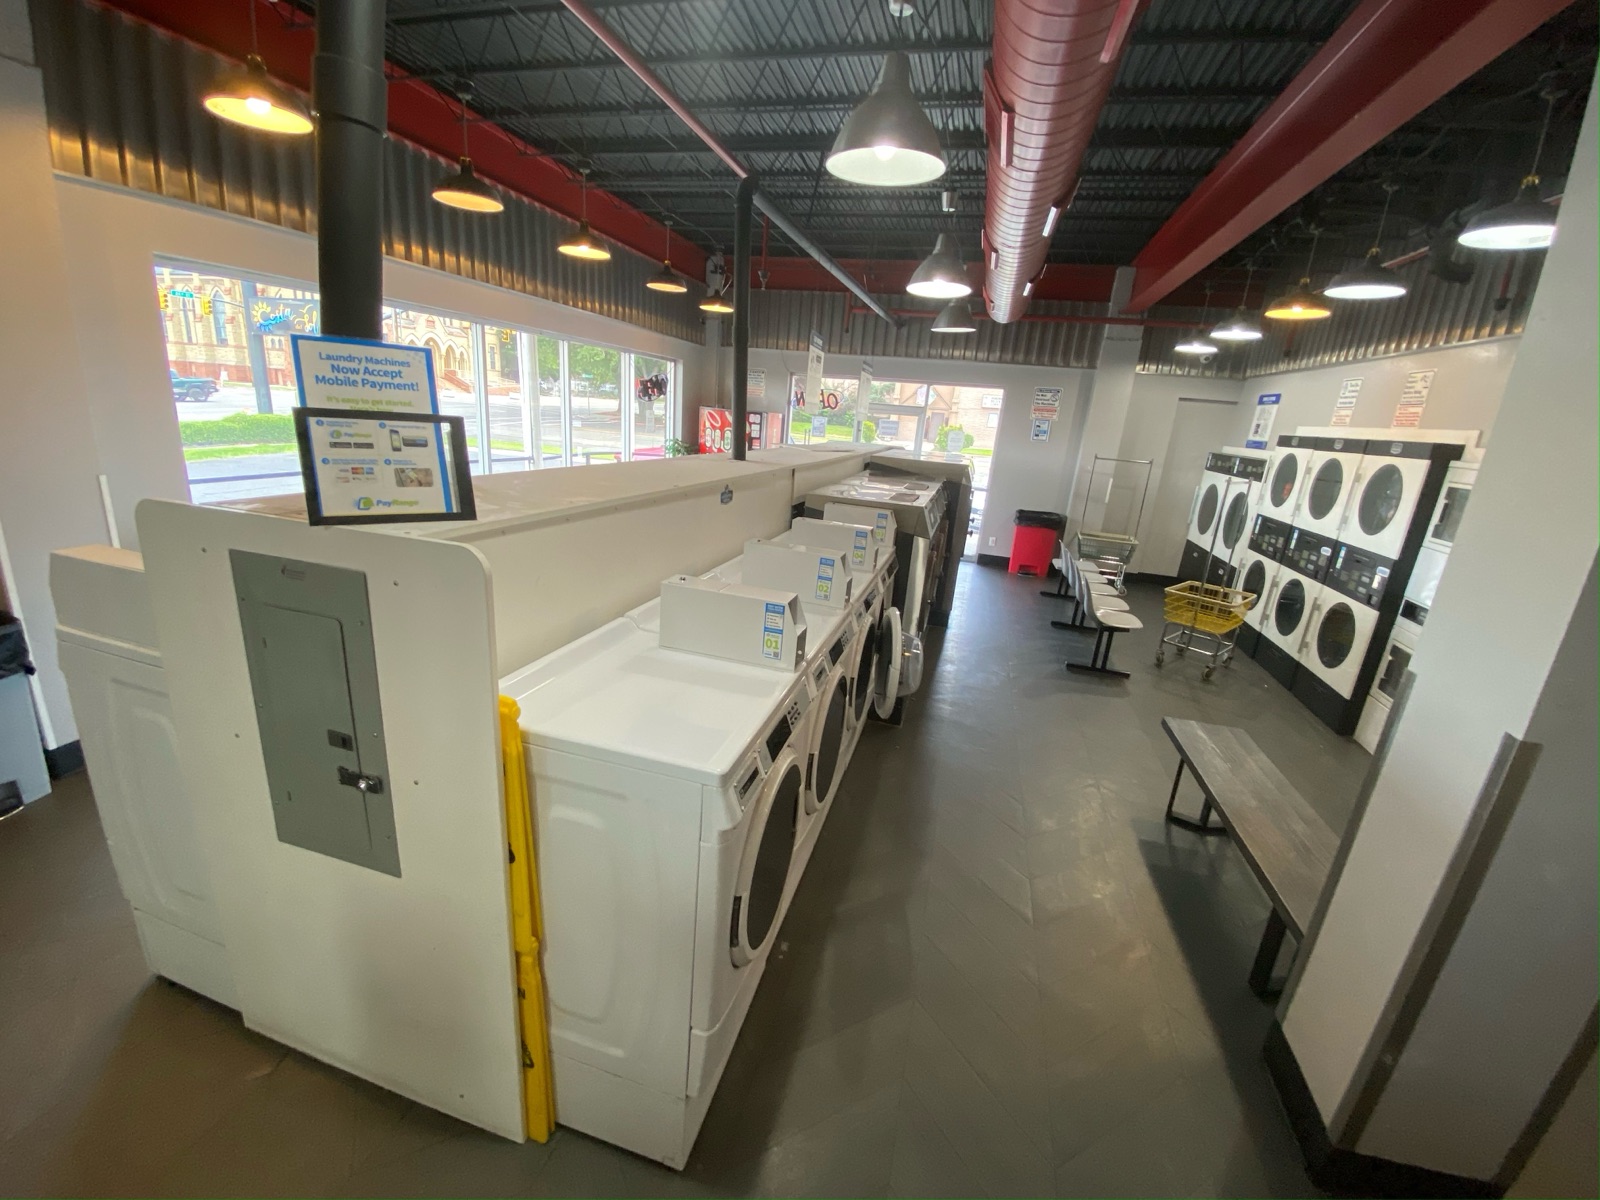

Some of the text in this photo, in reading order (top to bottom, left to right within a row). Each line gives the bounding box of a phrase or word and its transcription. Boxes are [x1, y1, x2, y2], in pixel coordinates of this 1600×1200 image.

[318, 352, 411, 368] Laundry Machines
[330, 364, 403, 380] Now Accept
[314, 374, 419, 391] Mobile Payment!
[340, 397, 360, 406] easy
[360, 397, 370, 405] to
[371, 398, 383, 407] get
[818, 584, 829, 593] 02
[765, 638, 779, 650] 01
